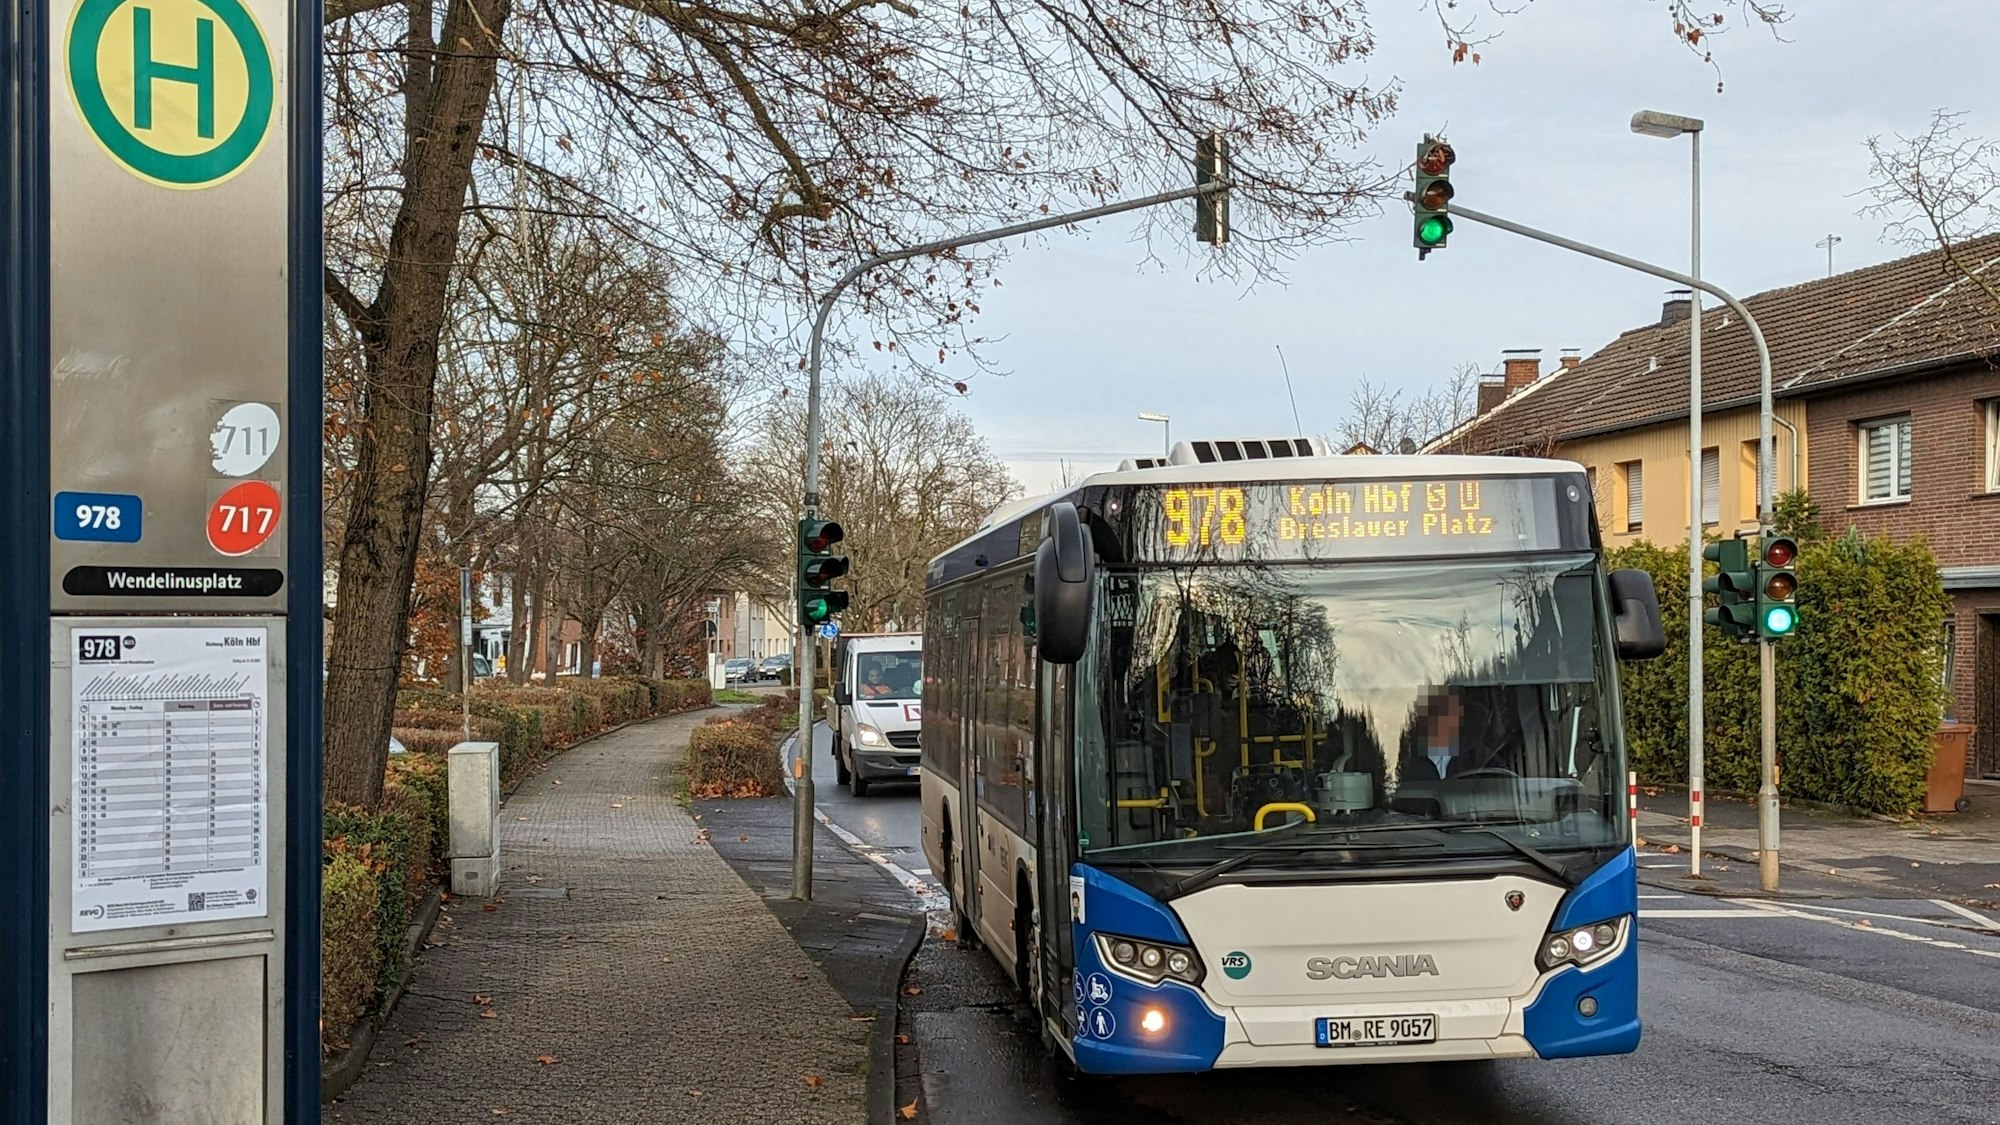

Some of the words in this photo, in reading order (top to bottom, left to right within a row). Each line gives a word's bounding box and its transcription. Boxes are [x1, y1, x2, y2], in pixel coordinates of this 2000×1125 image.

[133, 6, 214, 139] H
[219, 425, 268, 456] 711
[1364, 484, 1413, 513] Hbf
[76, 505, 120, 530] 978
[219, 504, 273, 534] 717
[1165, 488, 1245, 545] 978
[1280, 516, 1409, 540] Breslauer
[1422, 512, 1492, 536] Platz
[107, 571, 242, 592] Wendelinusplatz
[84, 638, 116, 658] 978
[224, 636, 244, 646] Köln
[246, 636, 260, 646] Hbf
[1222, 957, 1244, 967] VRS
[1306, 954, 1440, 980] SCANIA
[1329, 1022, 1351, 1040] BM
[1364, 1020, 1386, 1039] RE
[1390, 1018, 1432, 1038] 9057
